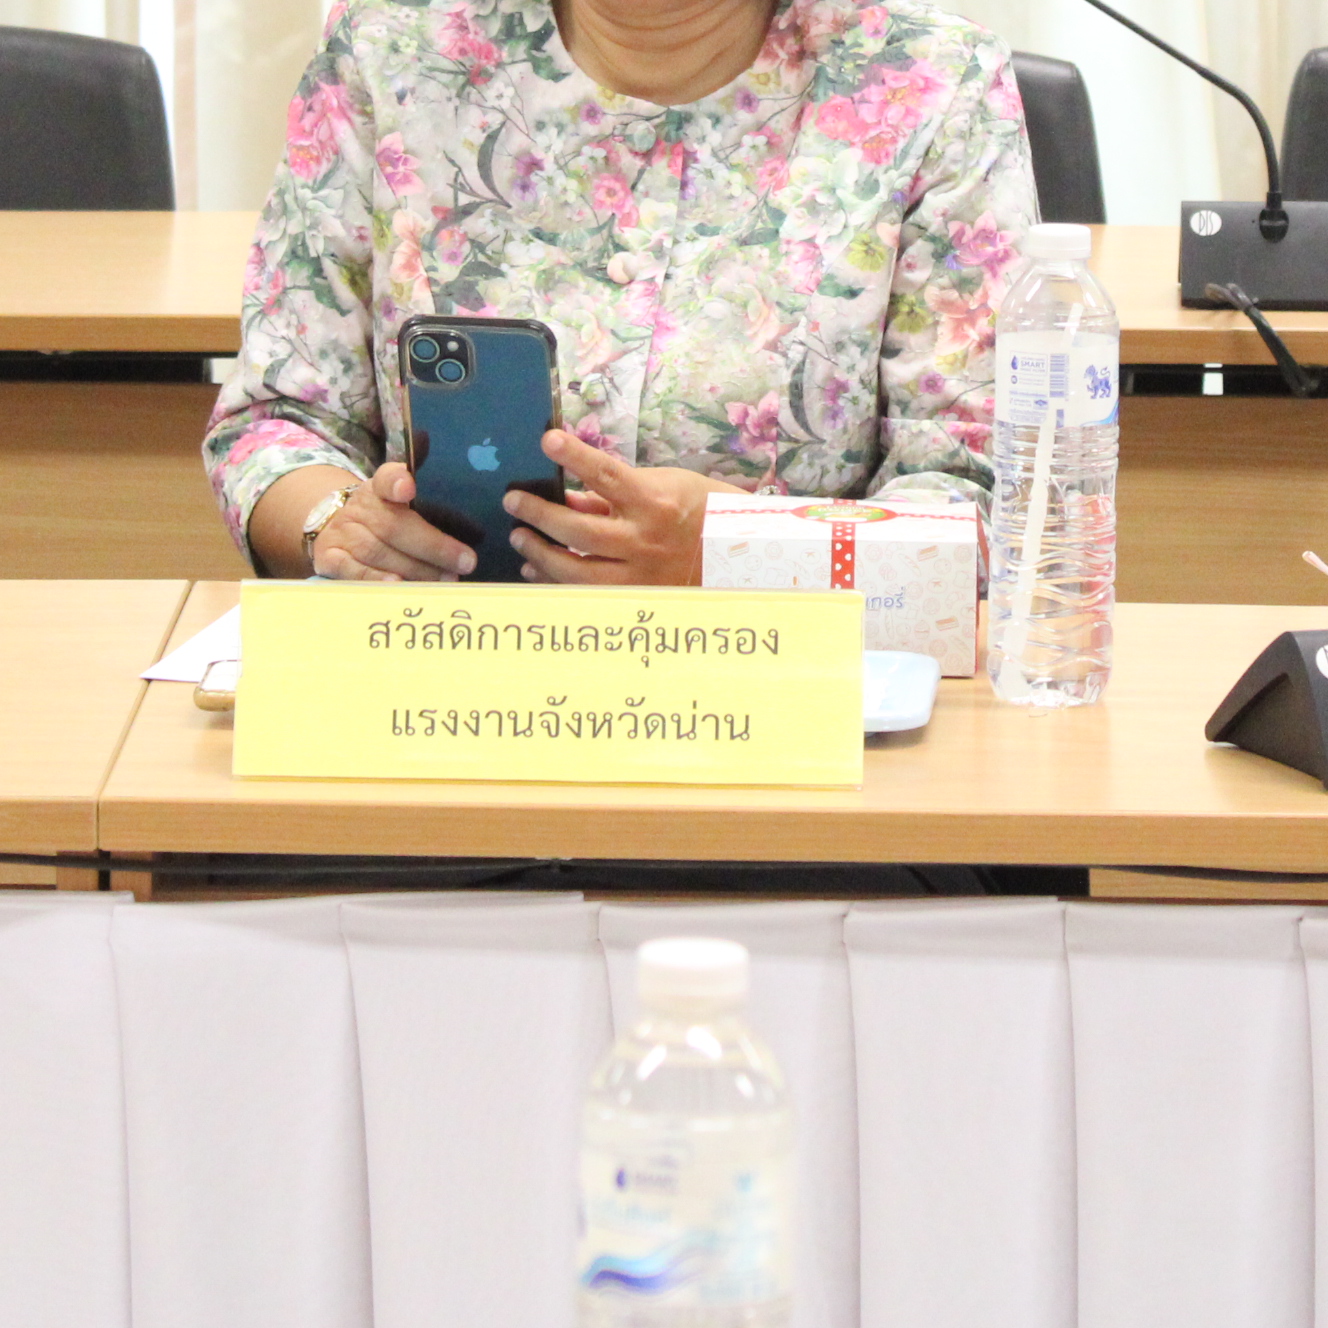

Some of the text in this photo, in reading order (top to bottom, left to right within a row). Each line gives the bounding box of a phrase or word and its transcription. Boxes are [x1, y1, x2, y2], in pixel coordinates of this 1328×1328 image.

[1020, 359, 1046, 369] SMART
[368, 608, 779, 669] สวัสดิการและคุ้มครอง
[391, 696, 750, 742] แรงงานจังหวัดน่าน
